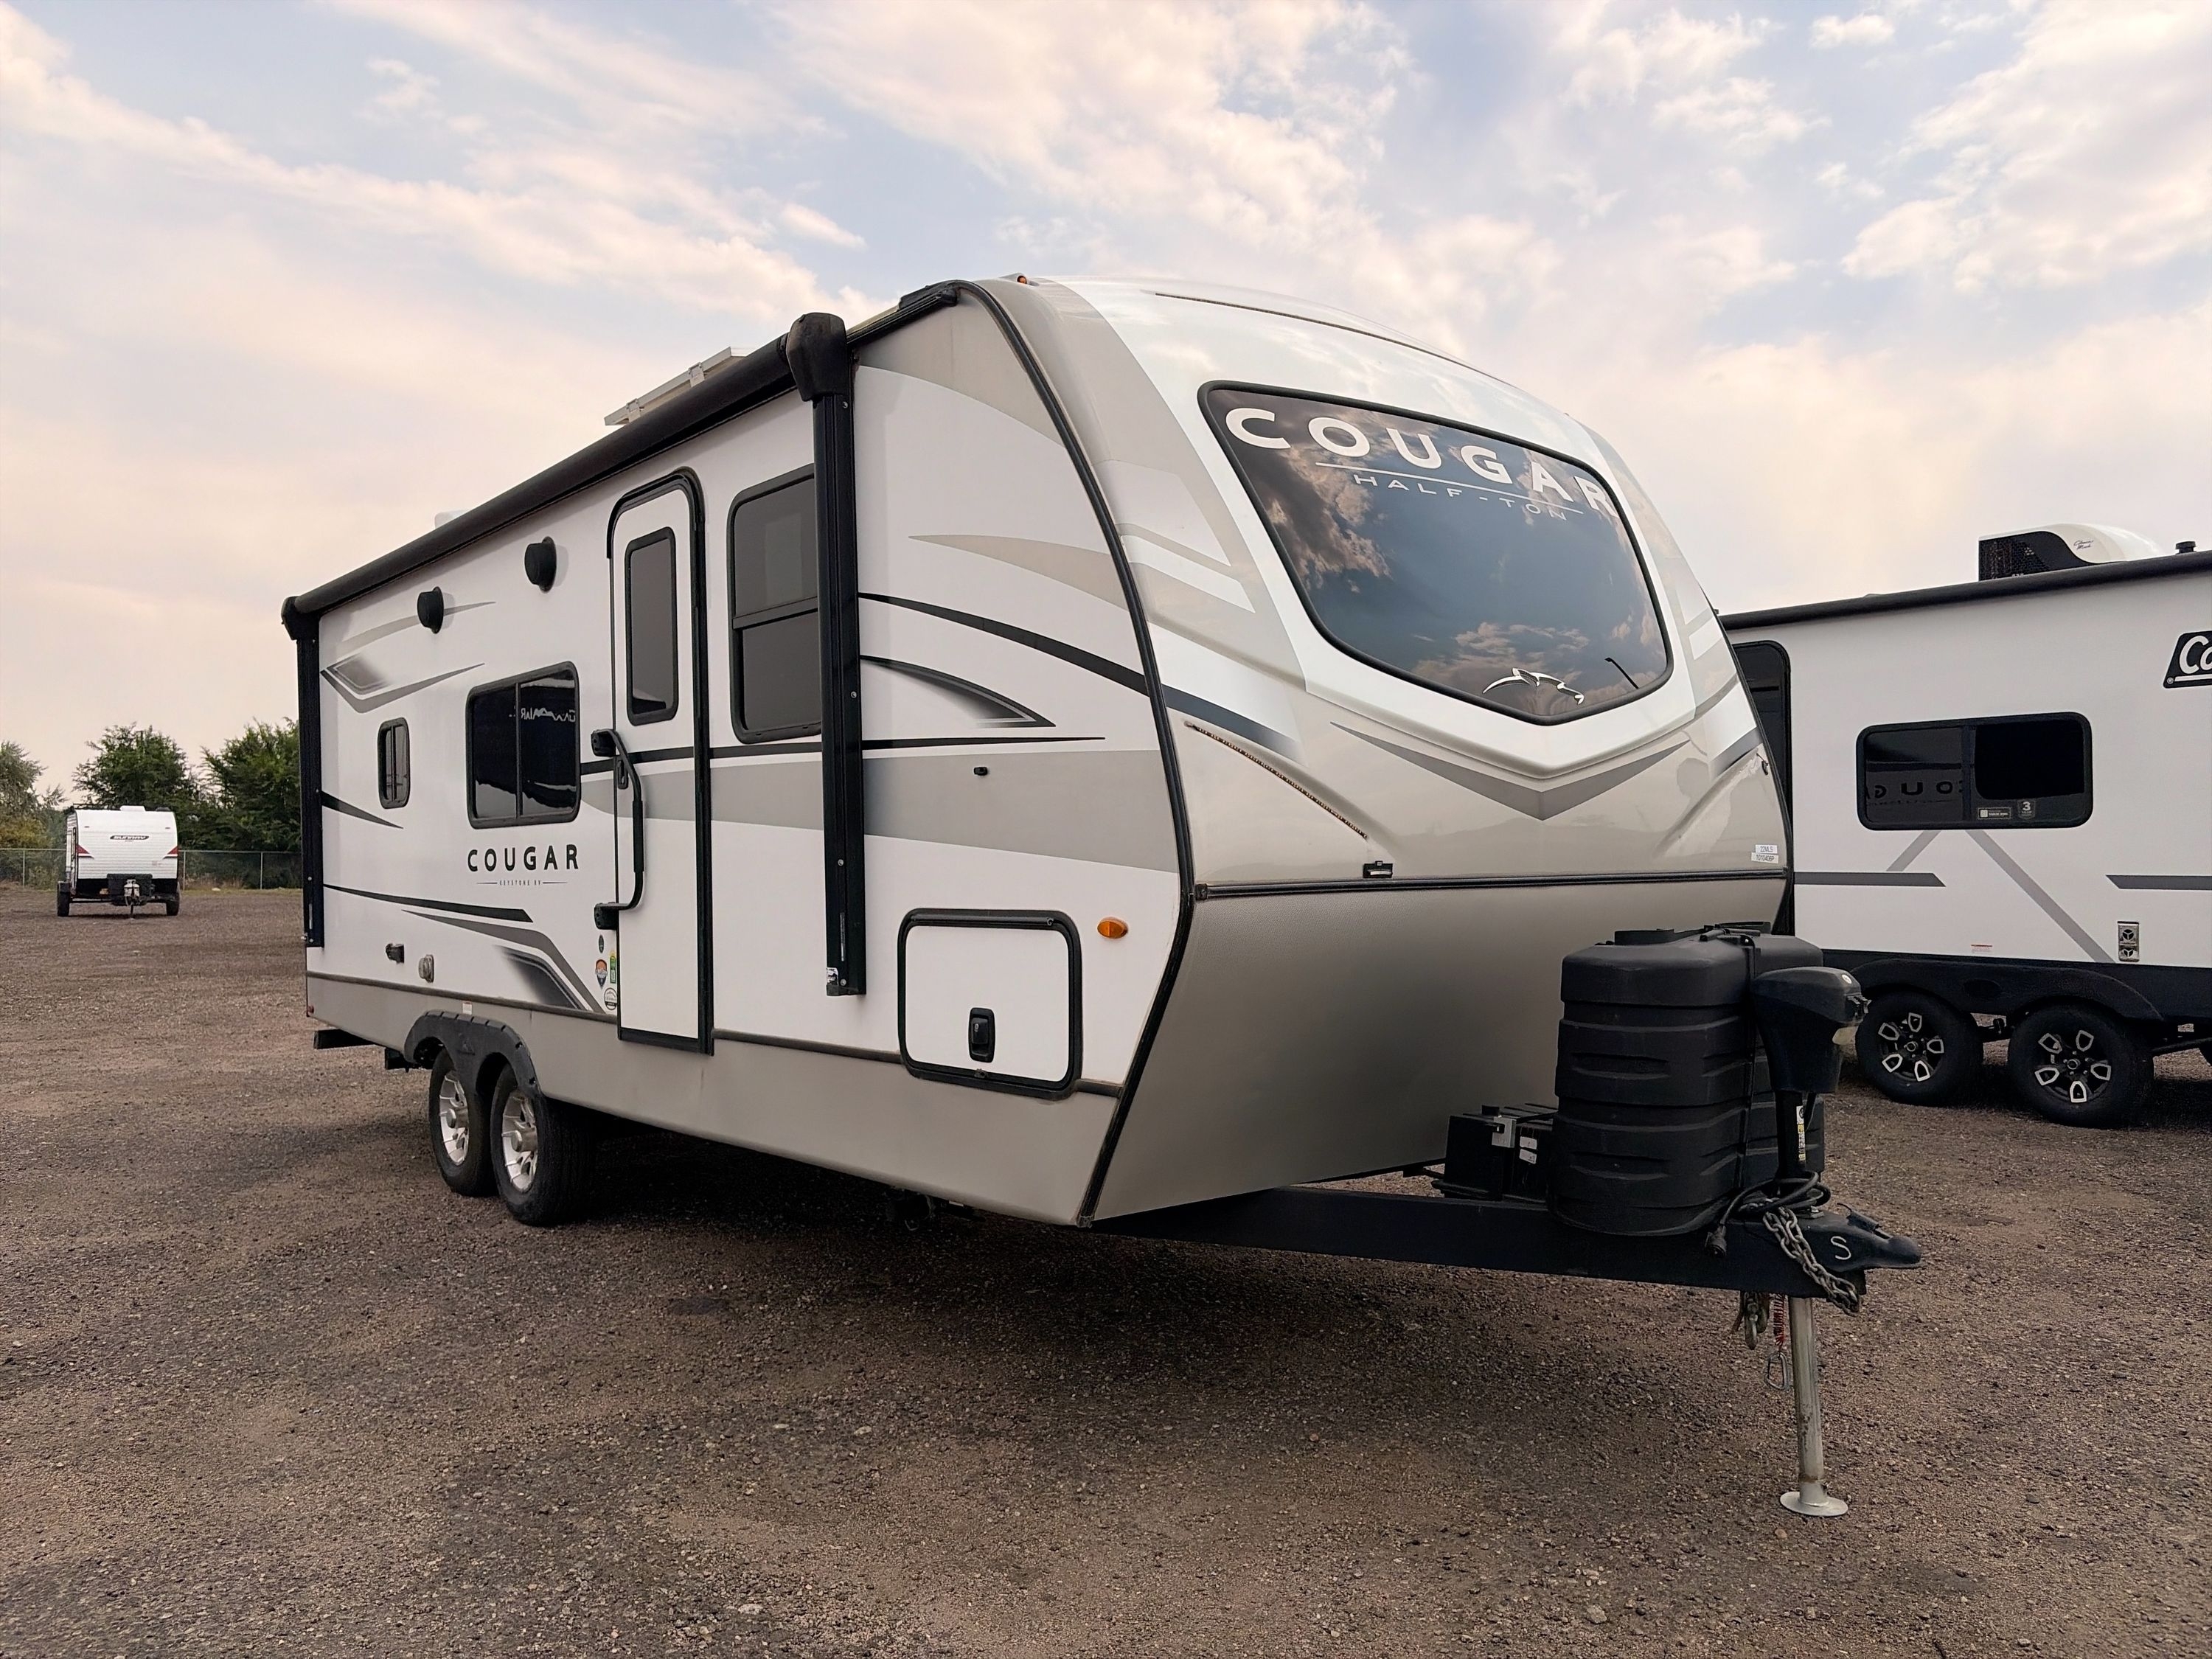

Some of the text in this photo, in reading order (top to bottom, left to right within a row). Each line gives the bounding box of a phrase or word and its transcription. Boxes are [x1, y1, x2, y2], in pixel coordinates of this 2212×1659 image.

[1225, 407, 1621, 519] COUGAR
[1353, 474, 1567, 521] HALF-TON
[2023, 801, 2031, 811] 3
[467, 844, 579, 872] COUGAR
[1830, 1236, 1851, 1260] S
